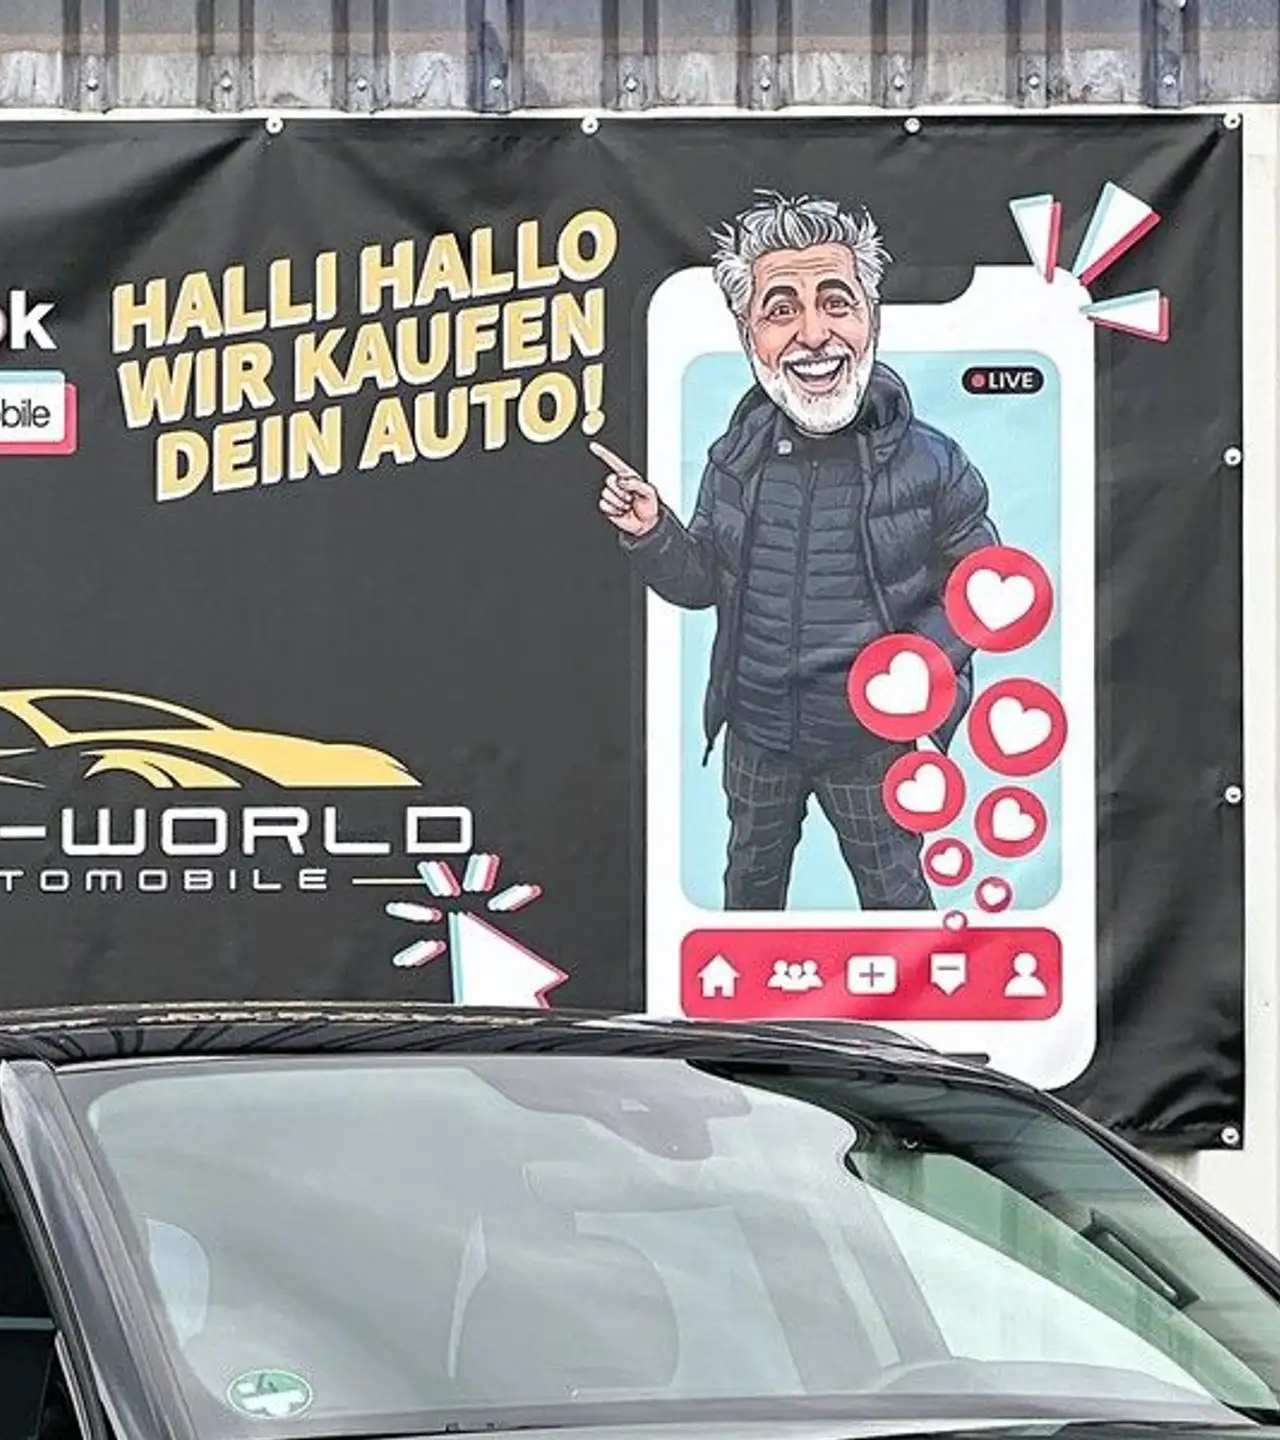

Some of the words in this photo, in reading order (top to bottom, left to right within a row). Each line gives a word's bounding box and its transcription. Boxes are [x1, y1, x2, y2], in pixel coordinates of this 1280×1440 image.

[112, 251, 338, 354] HALLI
[359, 208, 619, 314] HALLO
[118, 341, 276, 429] WIR
[293, 288, 605, 403] KAUFEN
[988, 372, 1034, 389] LIVE
[156, 406, 343, 503] DEIN
[357, 363, 606, 470] AUTO!
